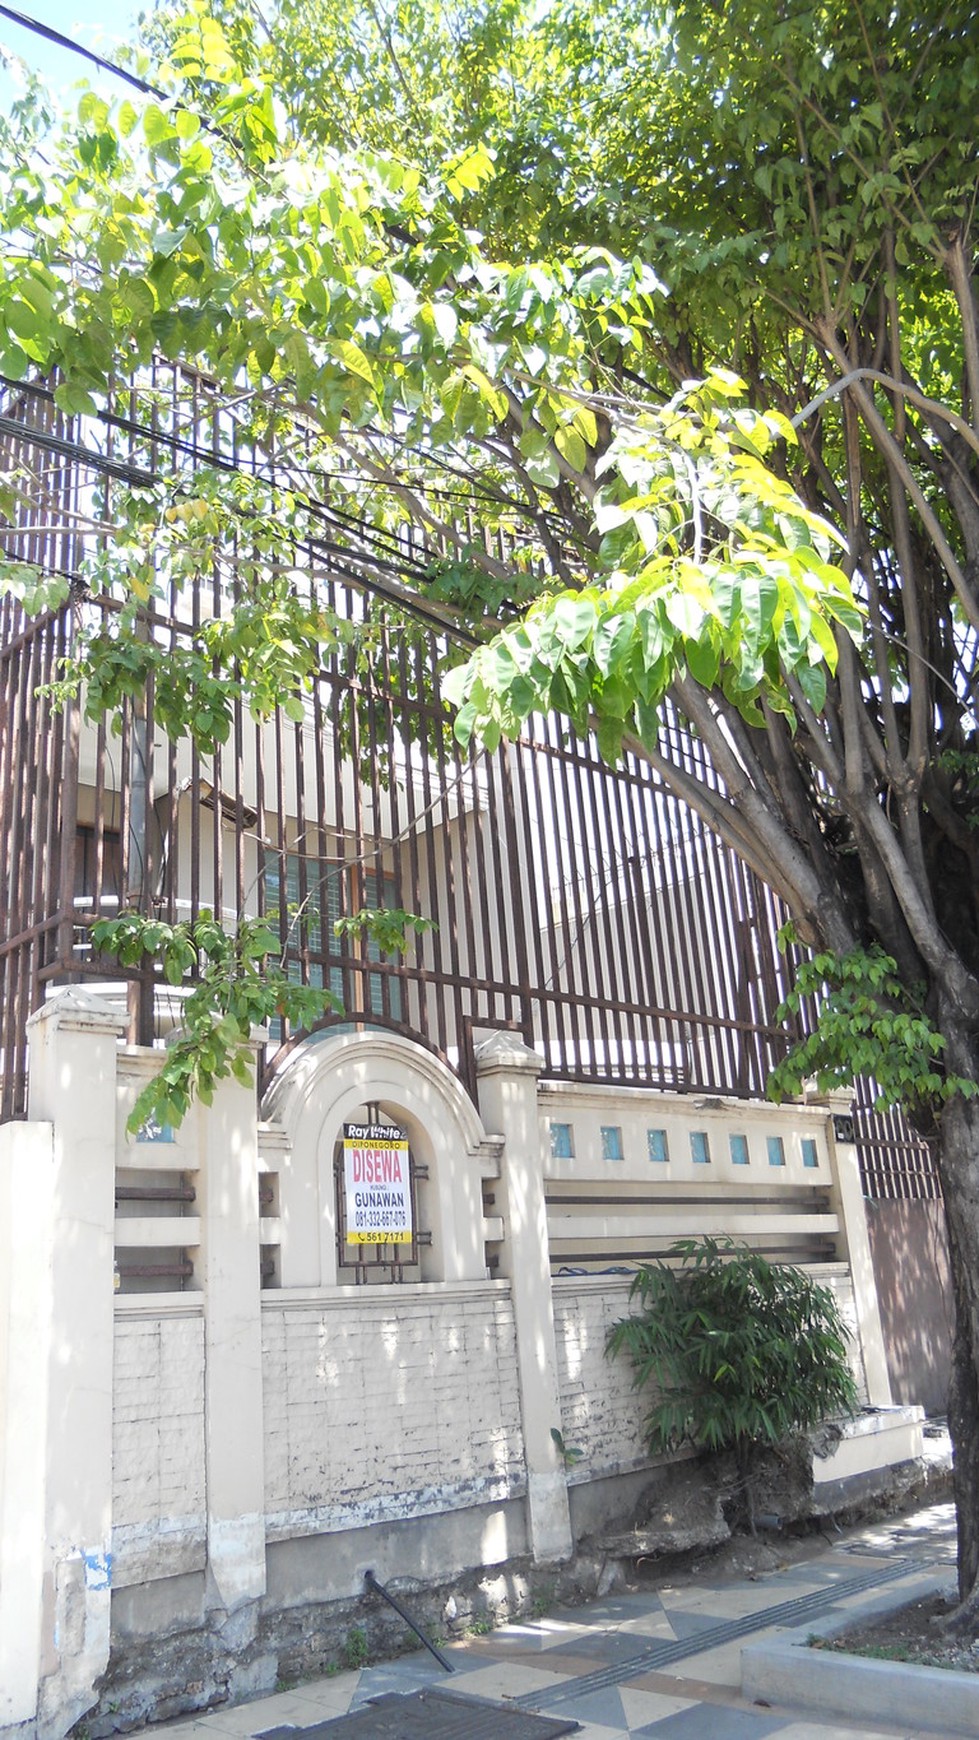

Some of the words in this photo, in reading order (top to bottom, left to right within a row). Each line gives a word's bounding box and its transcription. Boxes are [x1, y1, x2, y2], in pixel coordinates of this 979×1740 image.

[348, 1125, 369, 1140] Ray
[370, 1126, 400, 1139] White
[352, 1141, 401, 1149] DIPONEGORO
[353, 1150, 402, 1182] DISEWA
[355, 1192, 404, 1207] GUNAWAN
[366, 1232, 381, 1241] 561
[384, 1232, 403, 1241] 7171
